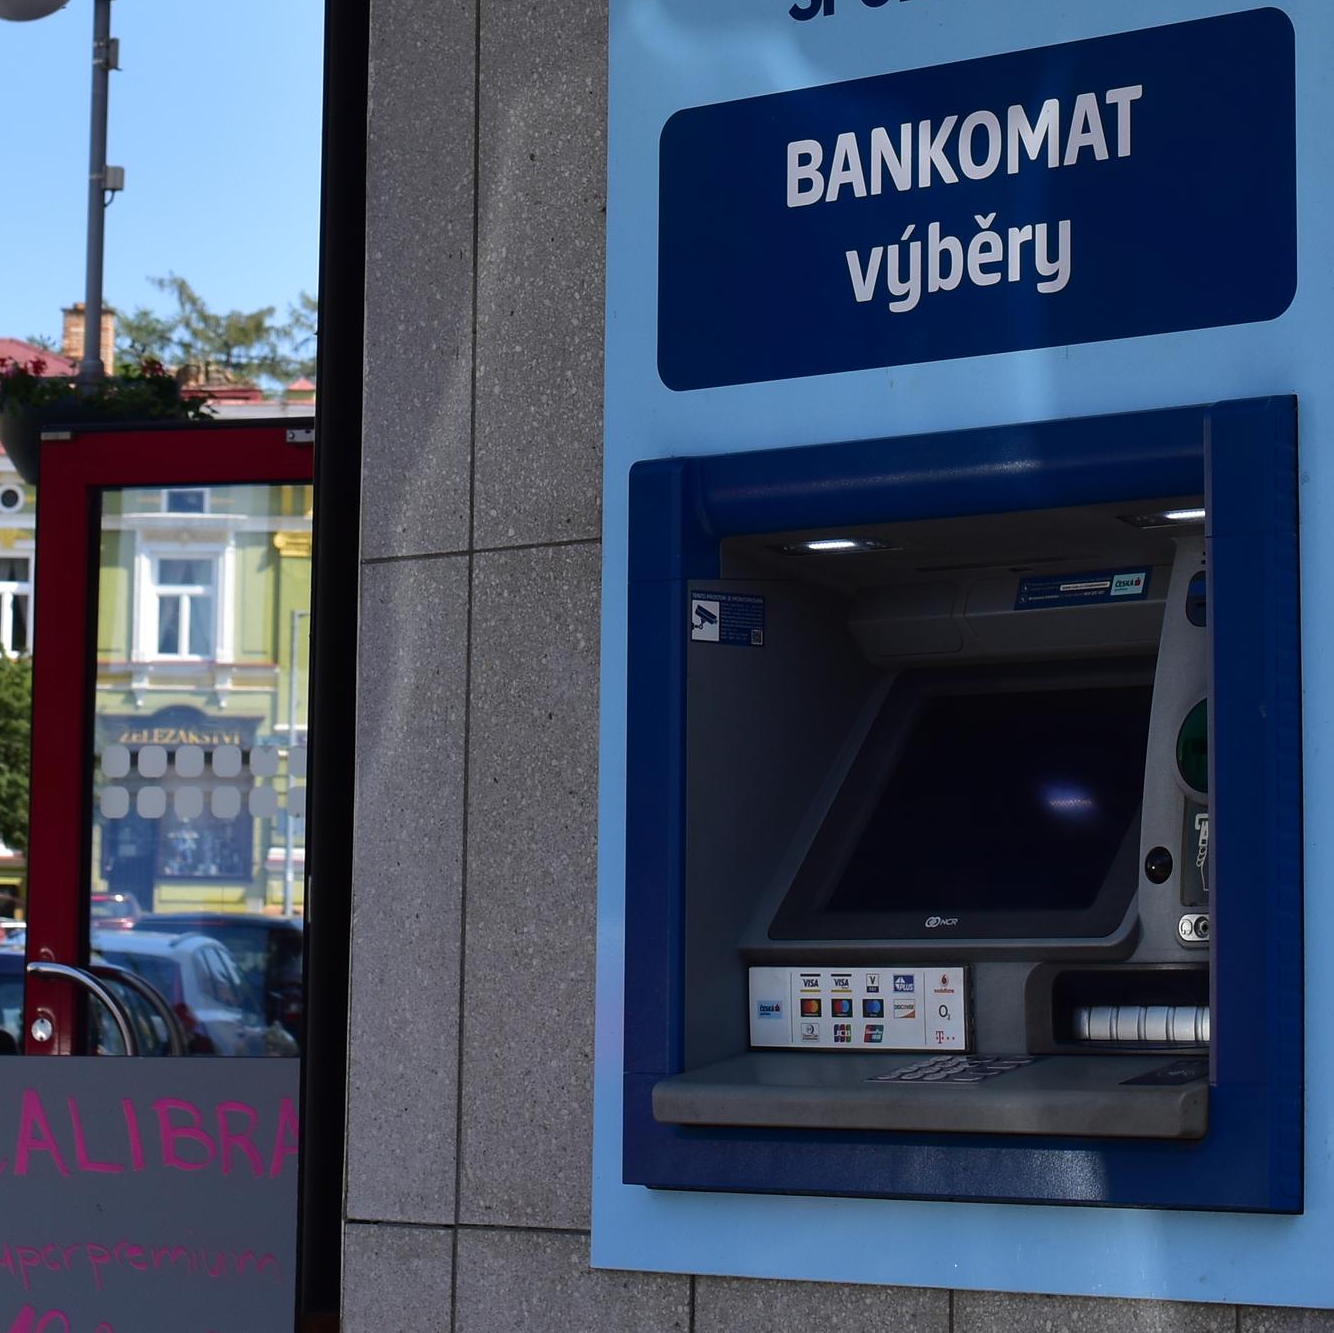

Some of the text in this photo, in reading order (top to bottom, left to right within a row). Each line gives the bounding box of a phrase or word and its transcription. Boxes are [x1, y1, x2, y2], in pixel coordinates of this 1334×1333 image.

[786, 84, 1143, 208] BANKOMAT
[845, 212, 1071, 313] výběry
[803, 978, 819, 988] VISA
[834, 978, 849, 987] VISA
